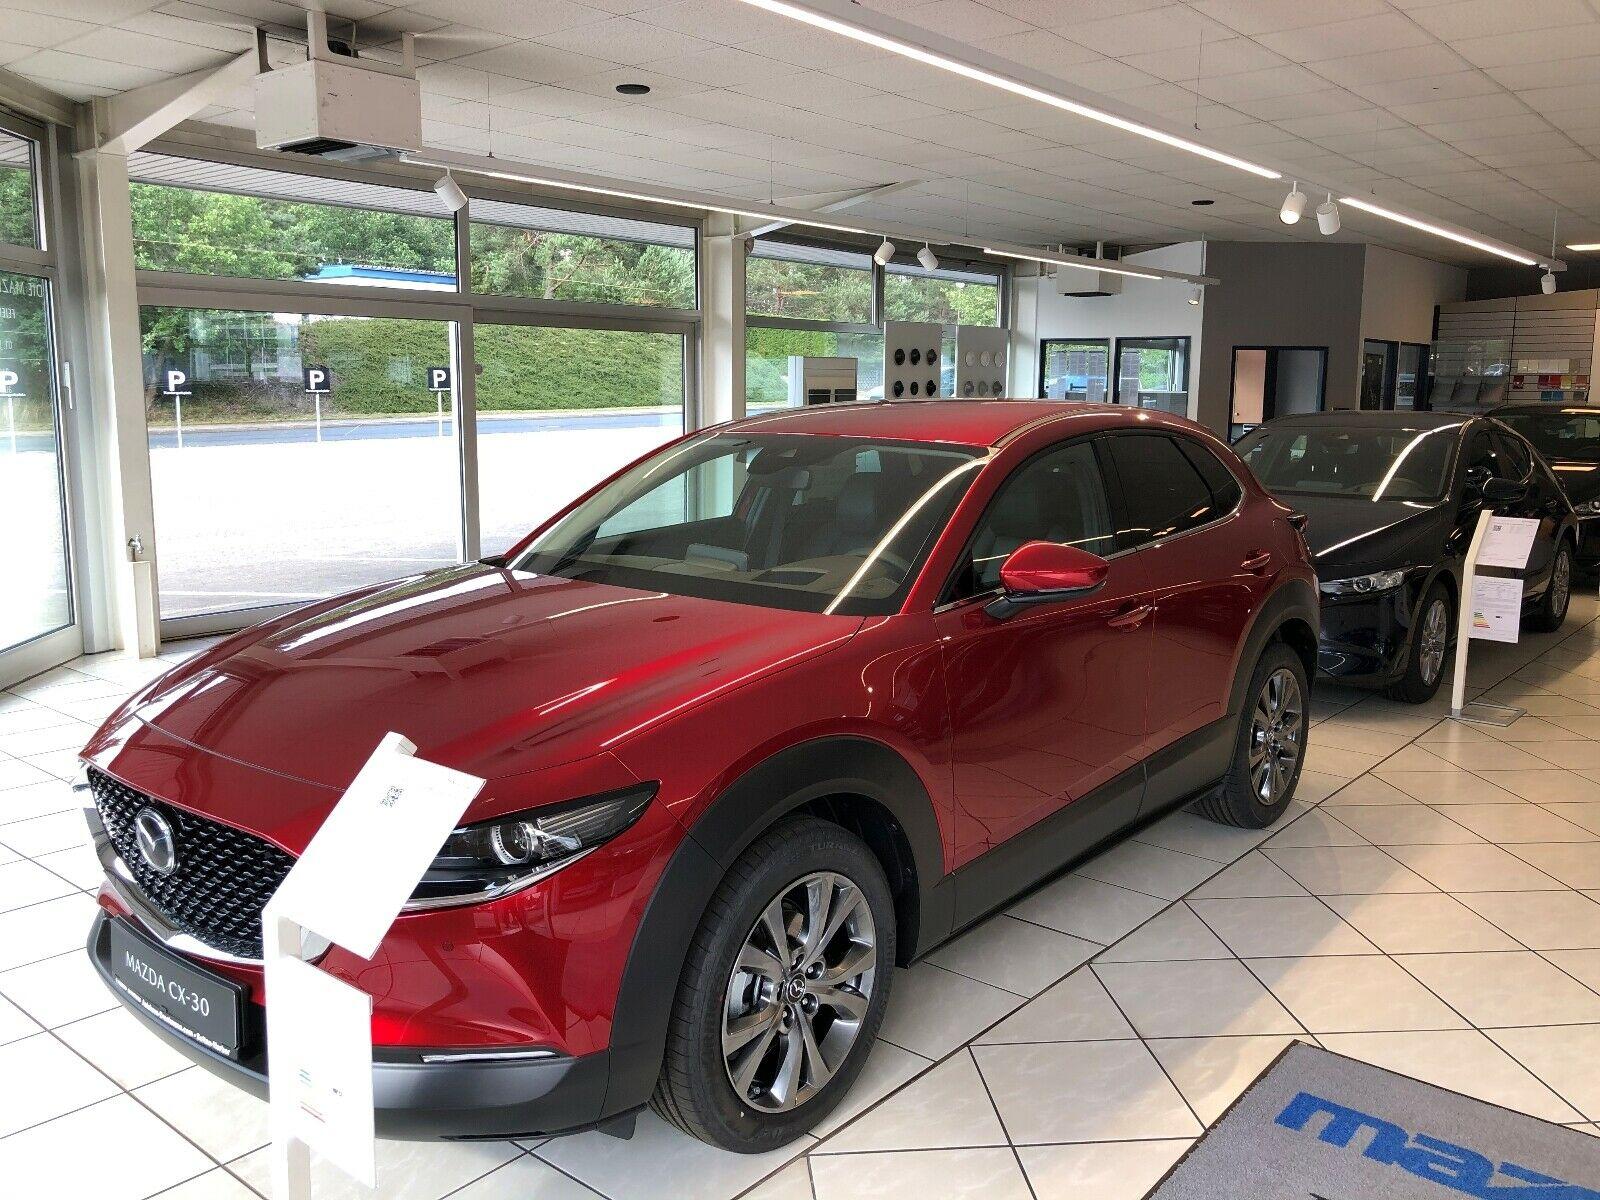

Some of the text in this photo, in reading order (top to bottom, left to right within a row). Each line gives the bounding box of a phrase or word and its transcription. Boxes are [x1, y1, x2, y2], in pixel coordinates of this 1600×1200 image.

[167, 370, 186, 392] P
[309, 370, 325, 390] P
[432, 369, 447, 388] P
[125, 950, 166, 993] MAZDA
[168, 981, 210, 1017] CX-30
